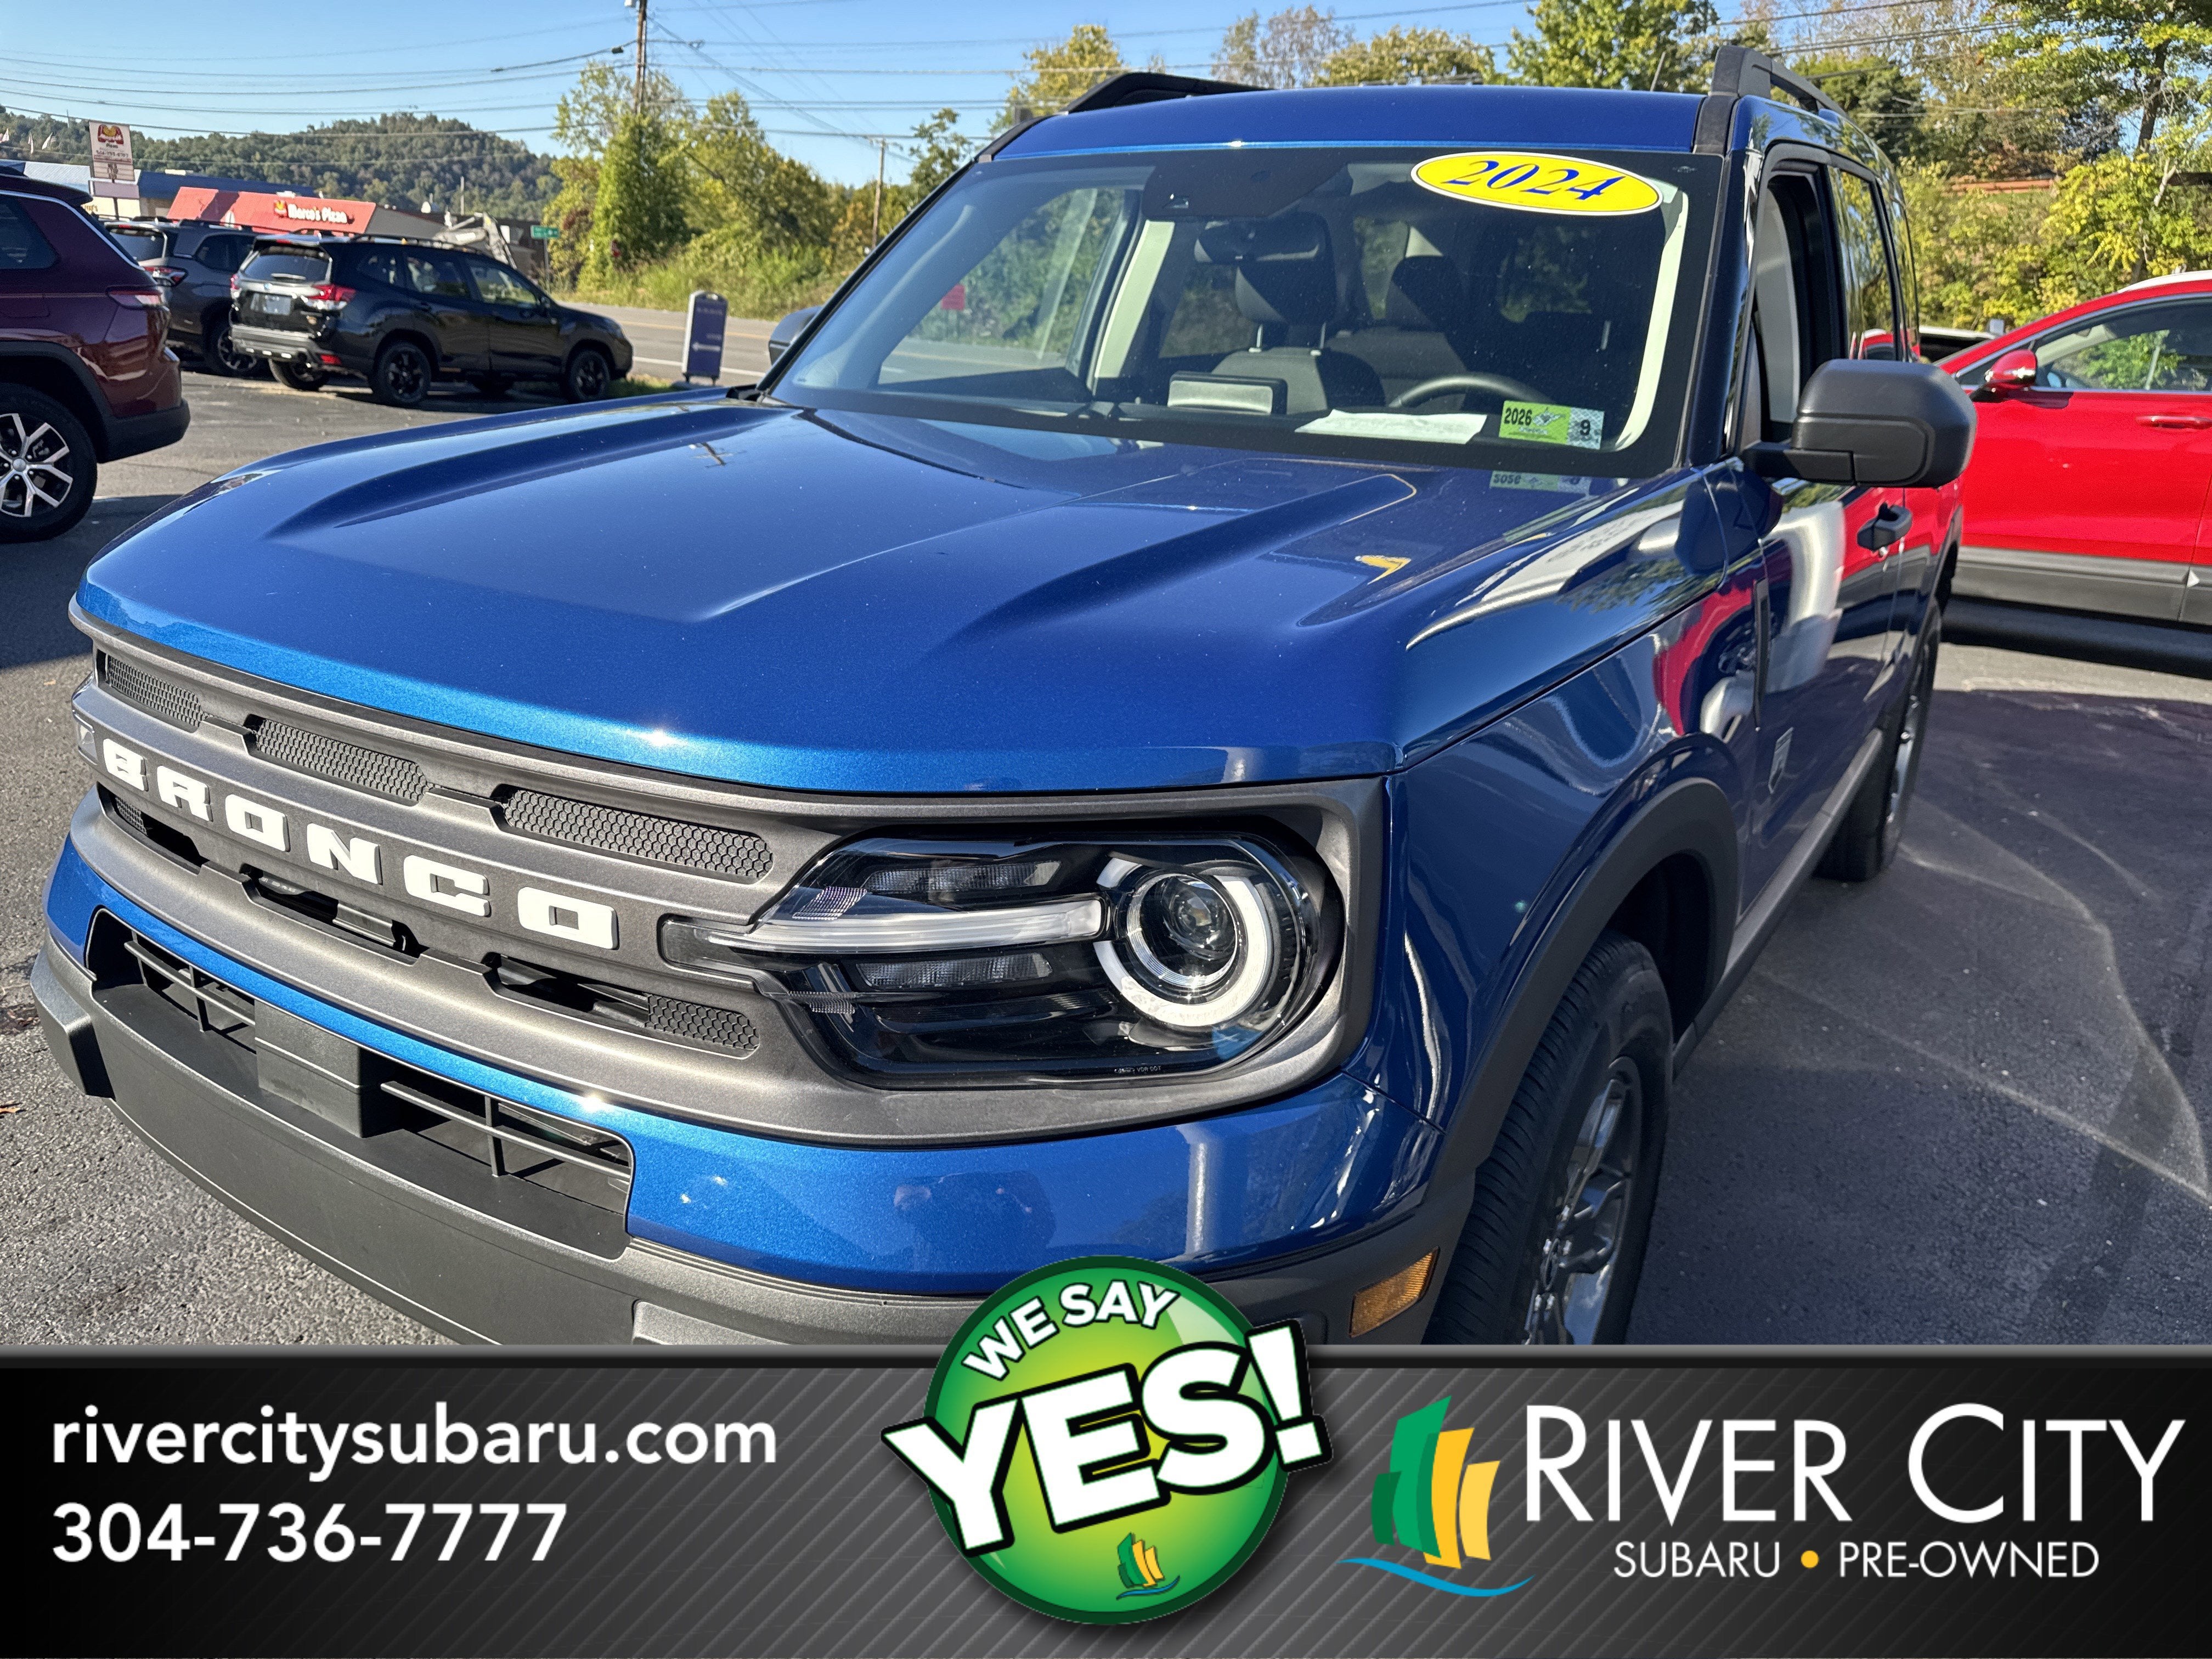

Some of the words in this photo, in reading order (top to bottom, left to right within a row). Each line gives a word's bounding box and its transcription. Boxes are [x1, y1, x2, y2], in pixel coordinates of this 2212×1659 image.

[1441, 160, 1626, 200] 2024
[287, 204, 321, 221] Marco's
[322, 207, 347, 223] Pizza
[1504, 407, 1533, 426] 2026
[1580, 419, 1591, 436] 9
[103, 738, 618, 950] BRONCO
